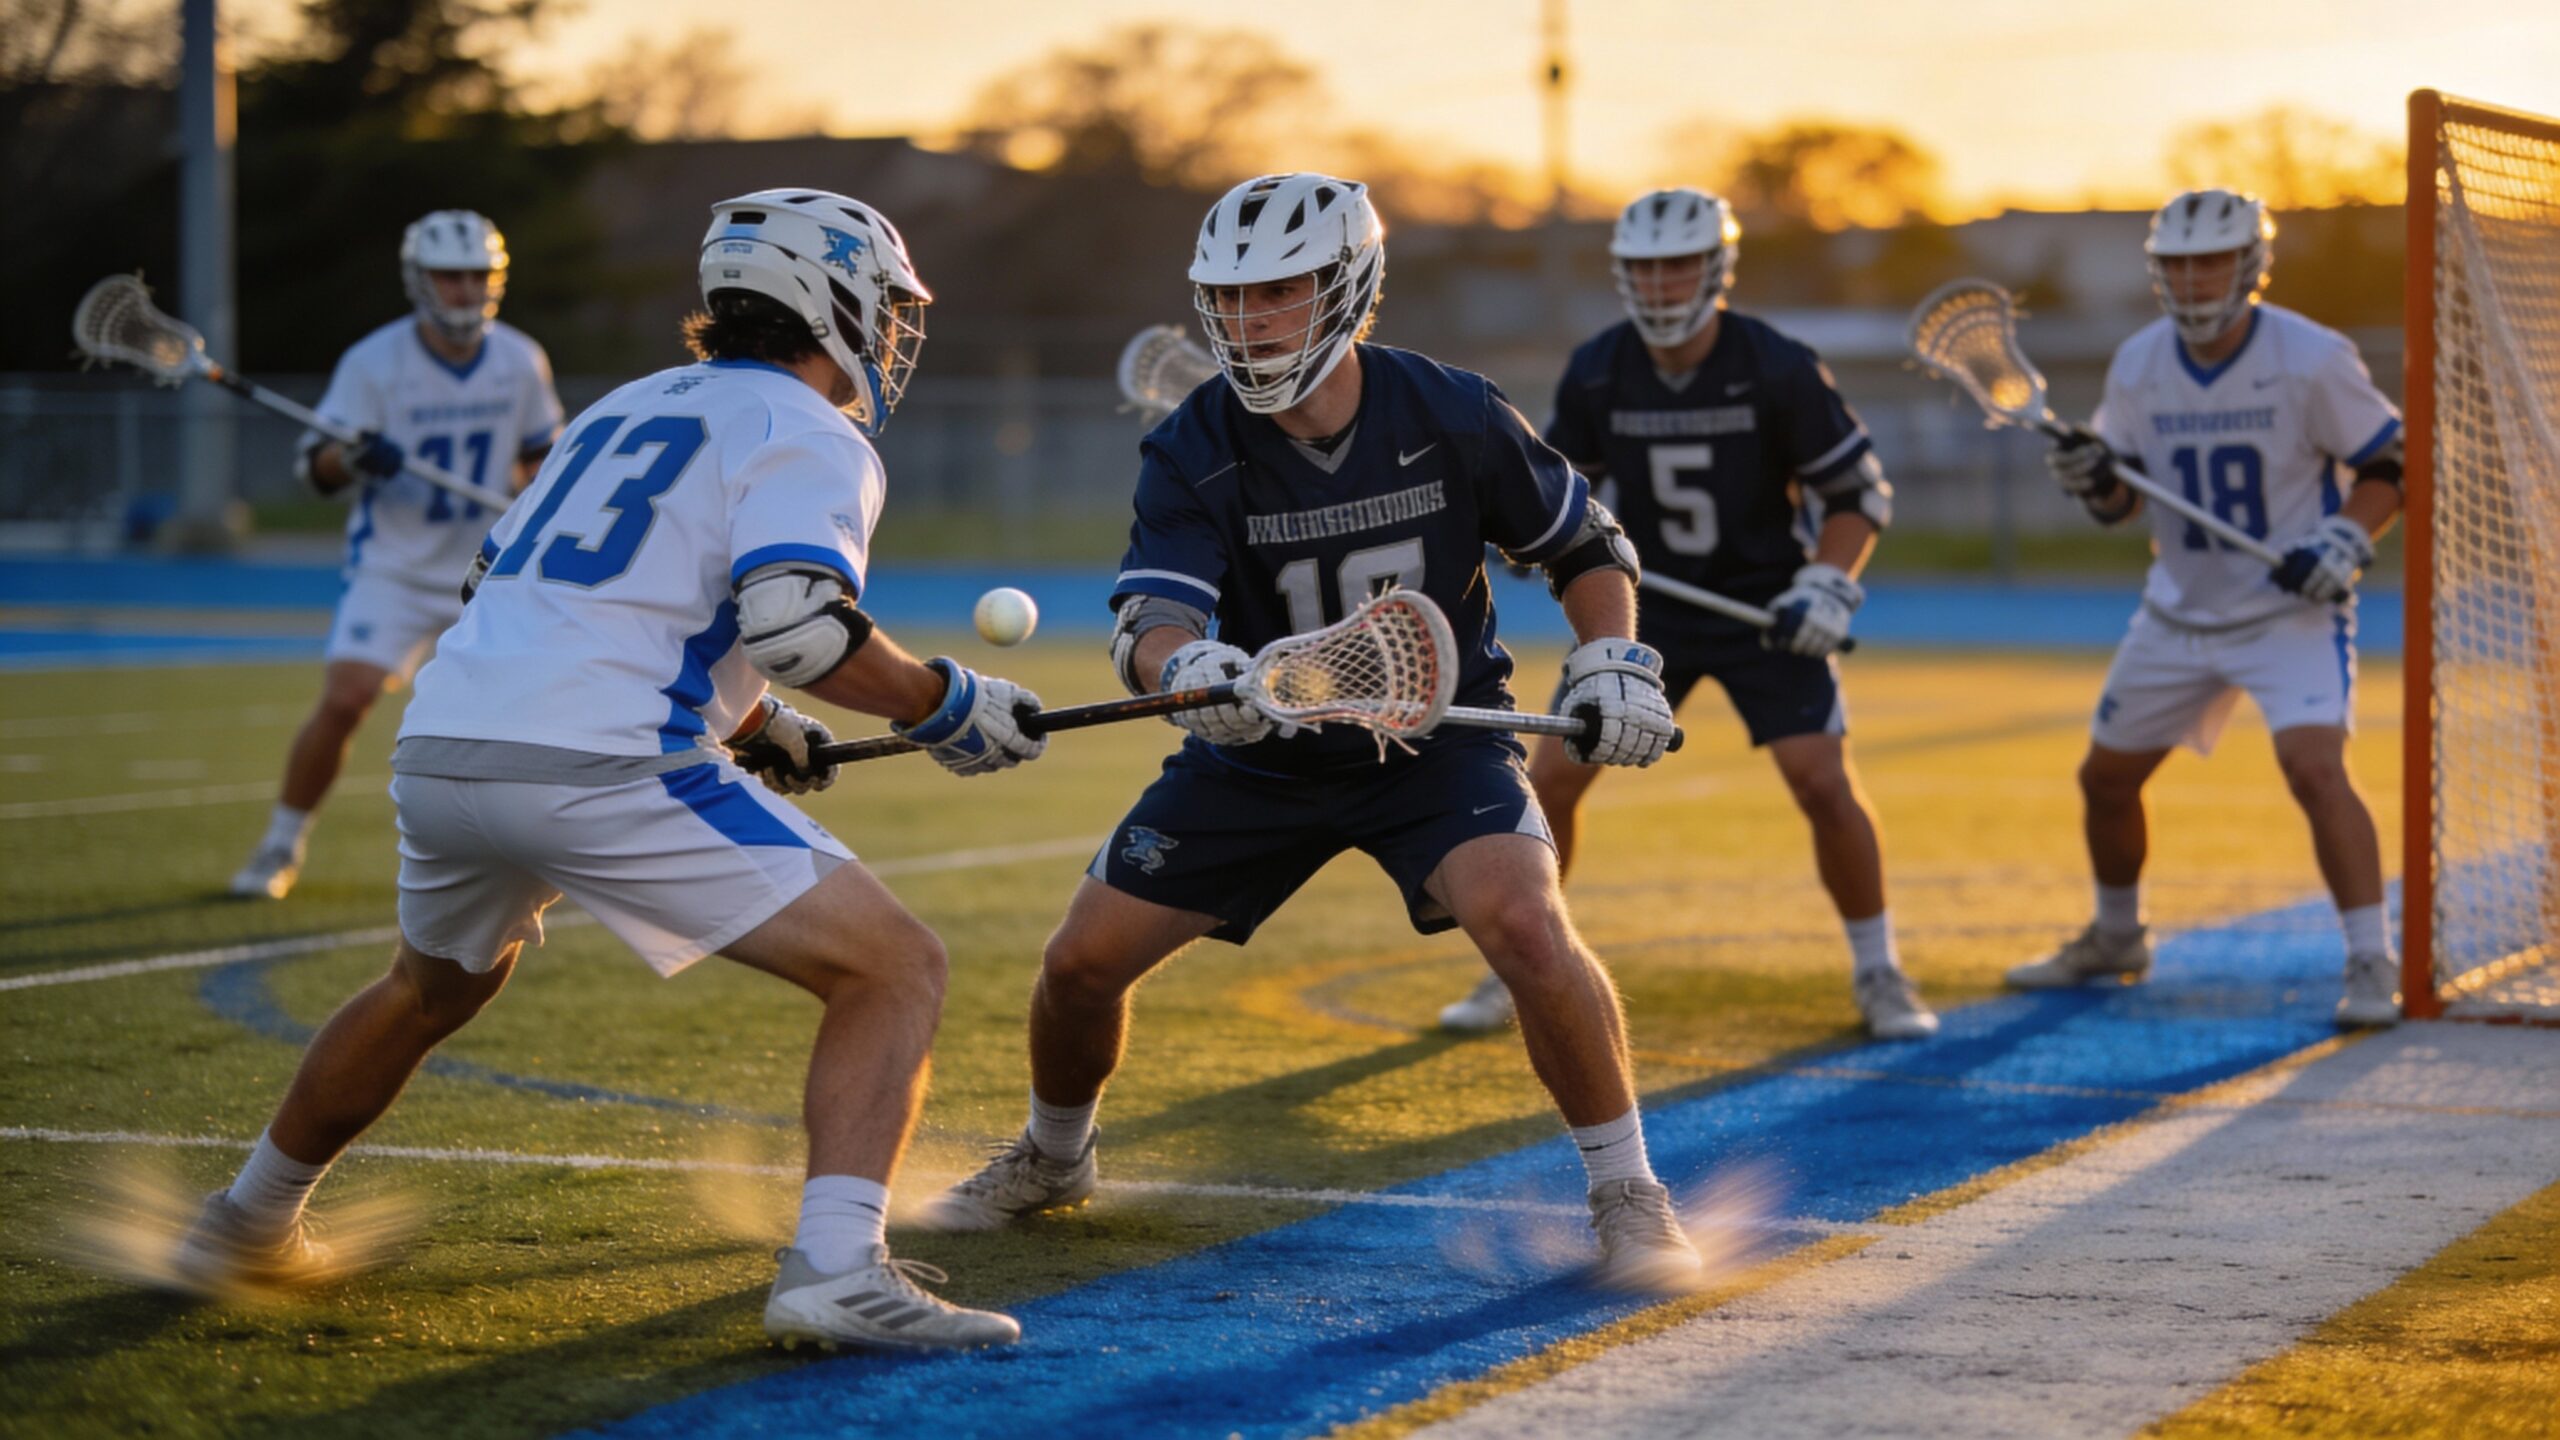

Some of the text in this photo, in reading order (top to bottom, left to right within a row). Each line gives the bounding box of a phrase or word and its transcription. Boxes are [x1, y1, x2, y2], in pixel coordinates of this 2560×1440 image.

[487, 413, 711, 592] 13
[1648, 443, 1719, 556] 5
[2171, 443, 2269, 550] 18
